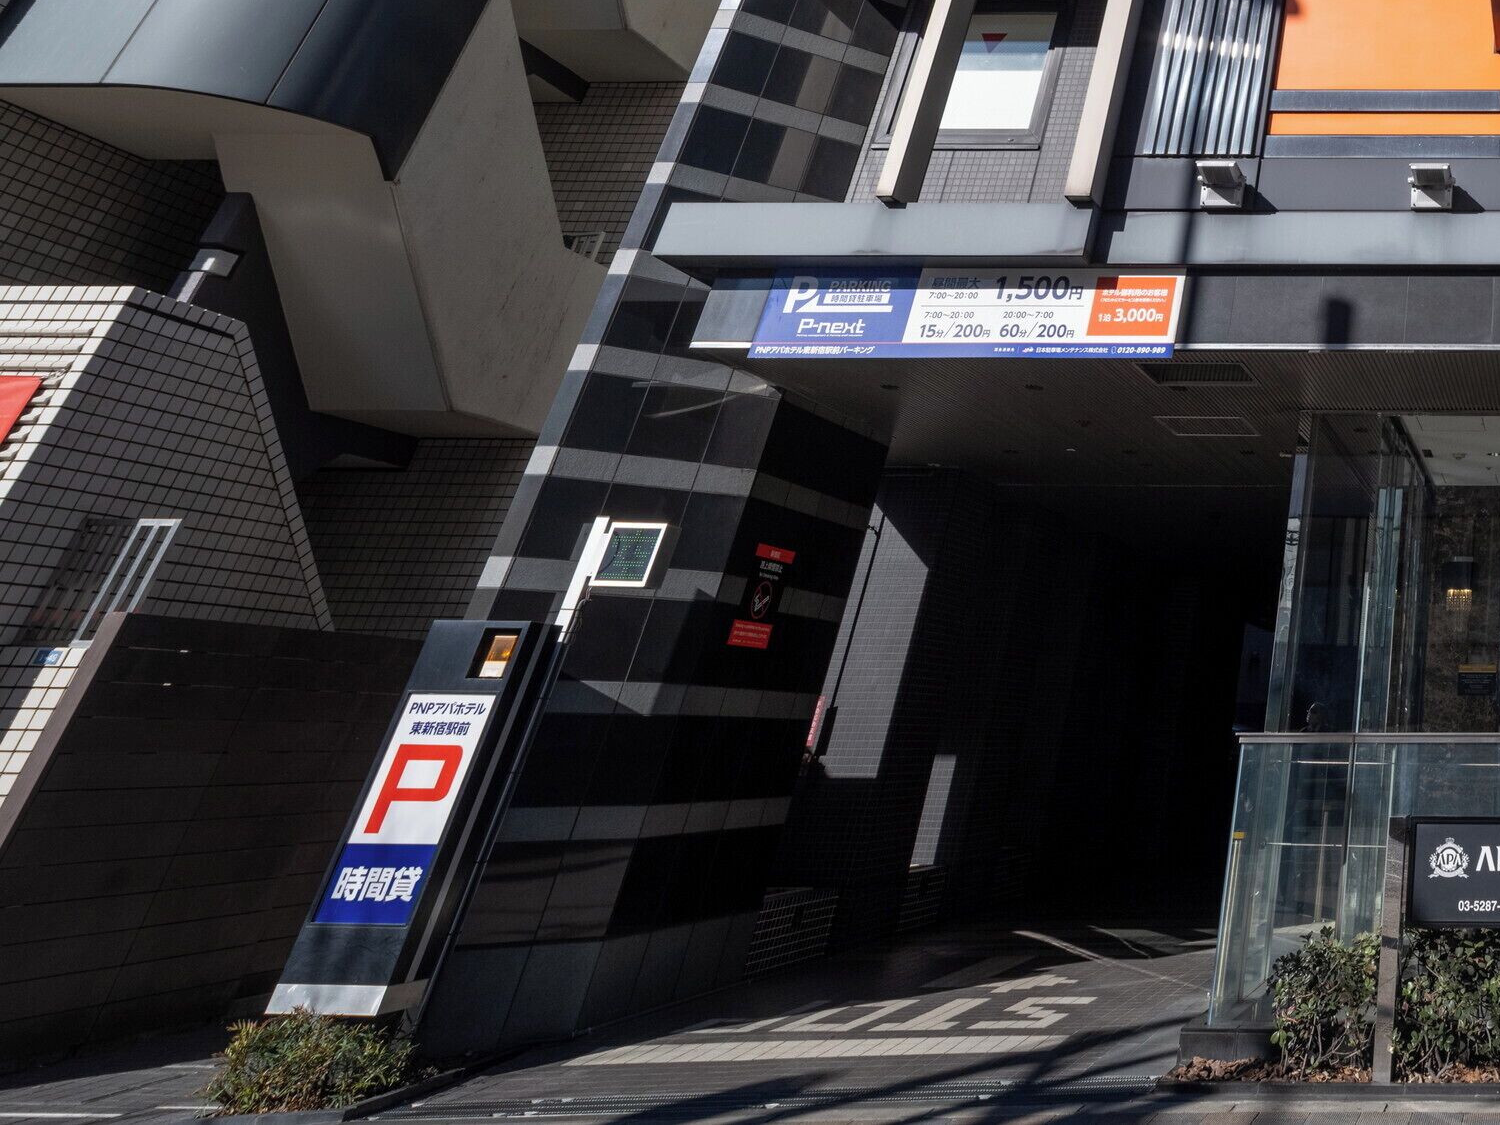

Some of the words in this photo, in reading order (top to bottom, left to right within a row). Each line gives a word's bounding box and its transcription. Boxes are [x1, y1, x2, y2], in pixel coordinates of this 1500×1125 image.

[829, 281, 892, 292] PARKING
[996, 275, 1084, 302] 1,500円
[831, 294, 883, 303] 時間貸駐車場
[1098, 313, 1112, 322] 1泊
[1113, 308, 1164, 323] 3,000円
[797, 318, 866, 333] P-next
[1117, 346, 1167, 354] 0120-890-989
[408, 701, 487, 715] PNPアパホテル
[409, 720, 472, 735] 東新宿駅前
[363, 744, 463, 834] P
[331, 865, 424, 904] 時間貸
